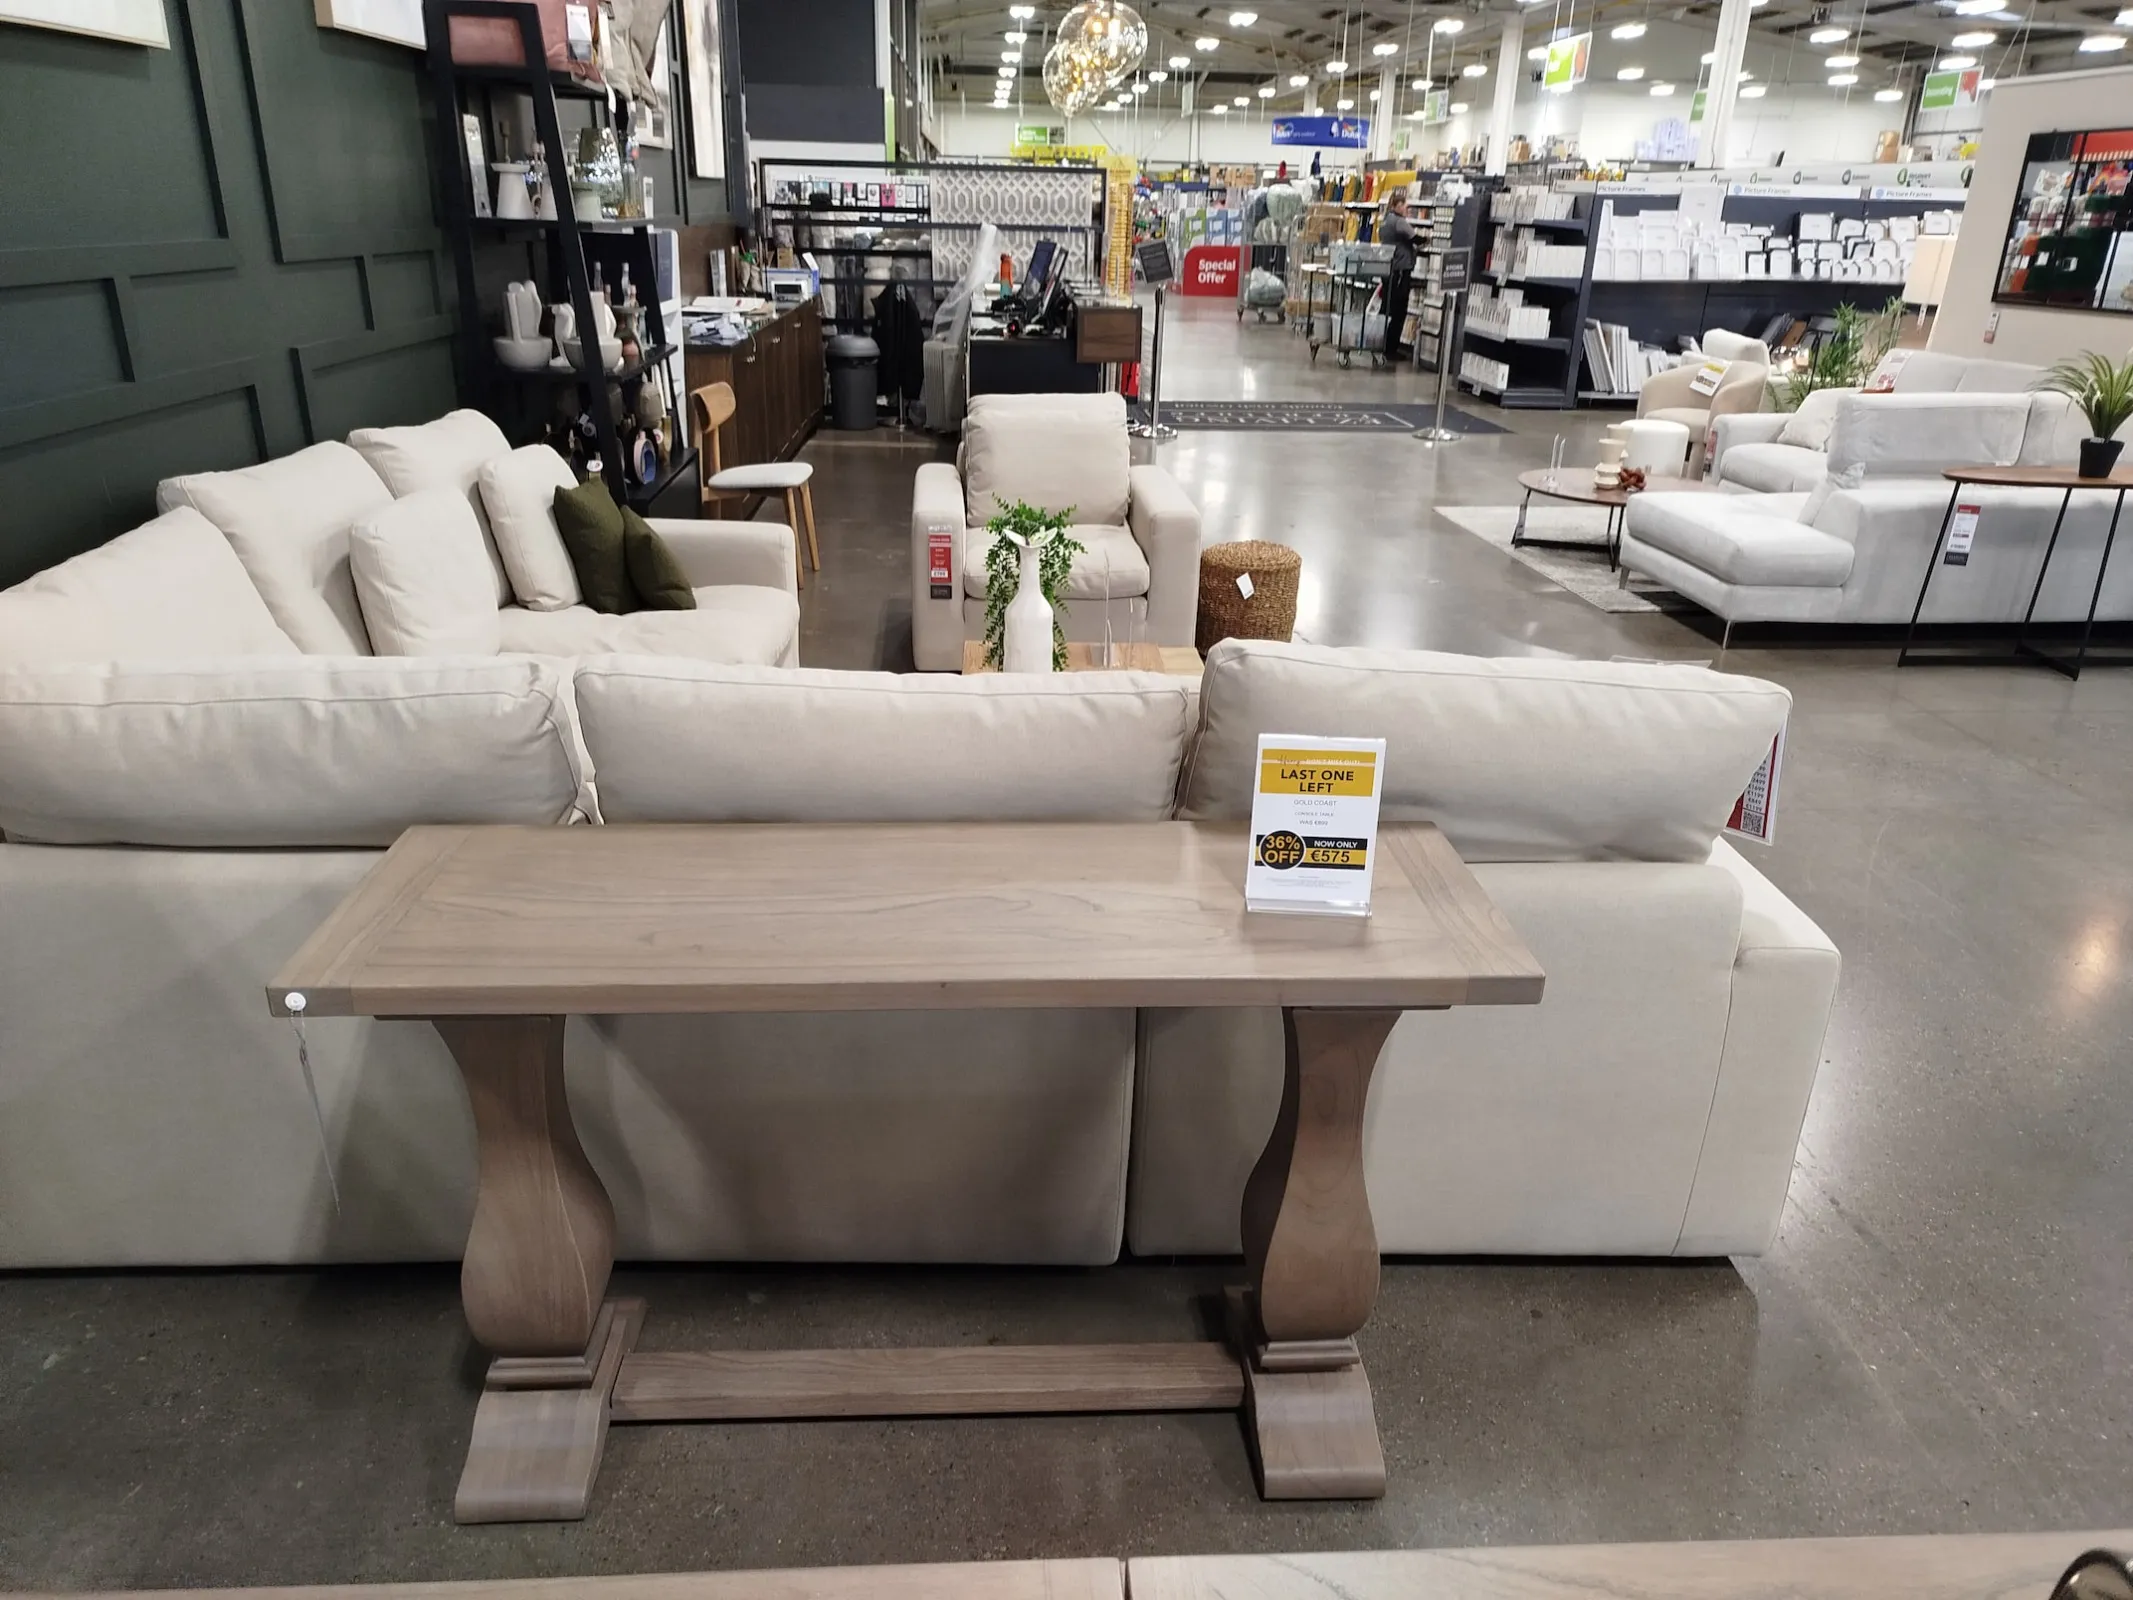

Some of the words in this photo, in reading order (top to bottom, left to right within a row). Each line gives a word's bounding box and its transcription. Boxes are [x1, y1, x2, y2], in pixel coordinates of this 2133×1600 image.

[1199, 259, 1236, 272] Special
[1198, 272, 1226, 284] Offer
[1281, 769, 1316, 780] LAST
[1321, 770, 1354, 781] ONE
[1299, 782, 1334, 793] LEFT
[1265, 835, 1301, 850] 36%
[1313, 840, 1335, 848] NOW
[1336, 841, 1358, 849] ONLY
[1264, 850, 1300, 864] OFF
[1311, 850, 1350, 863] €575
